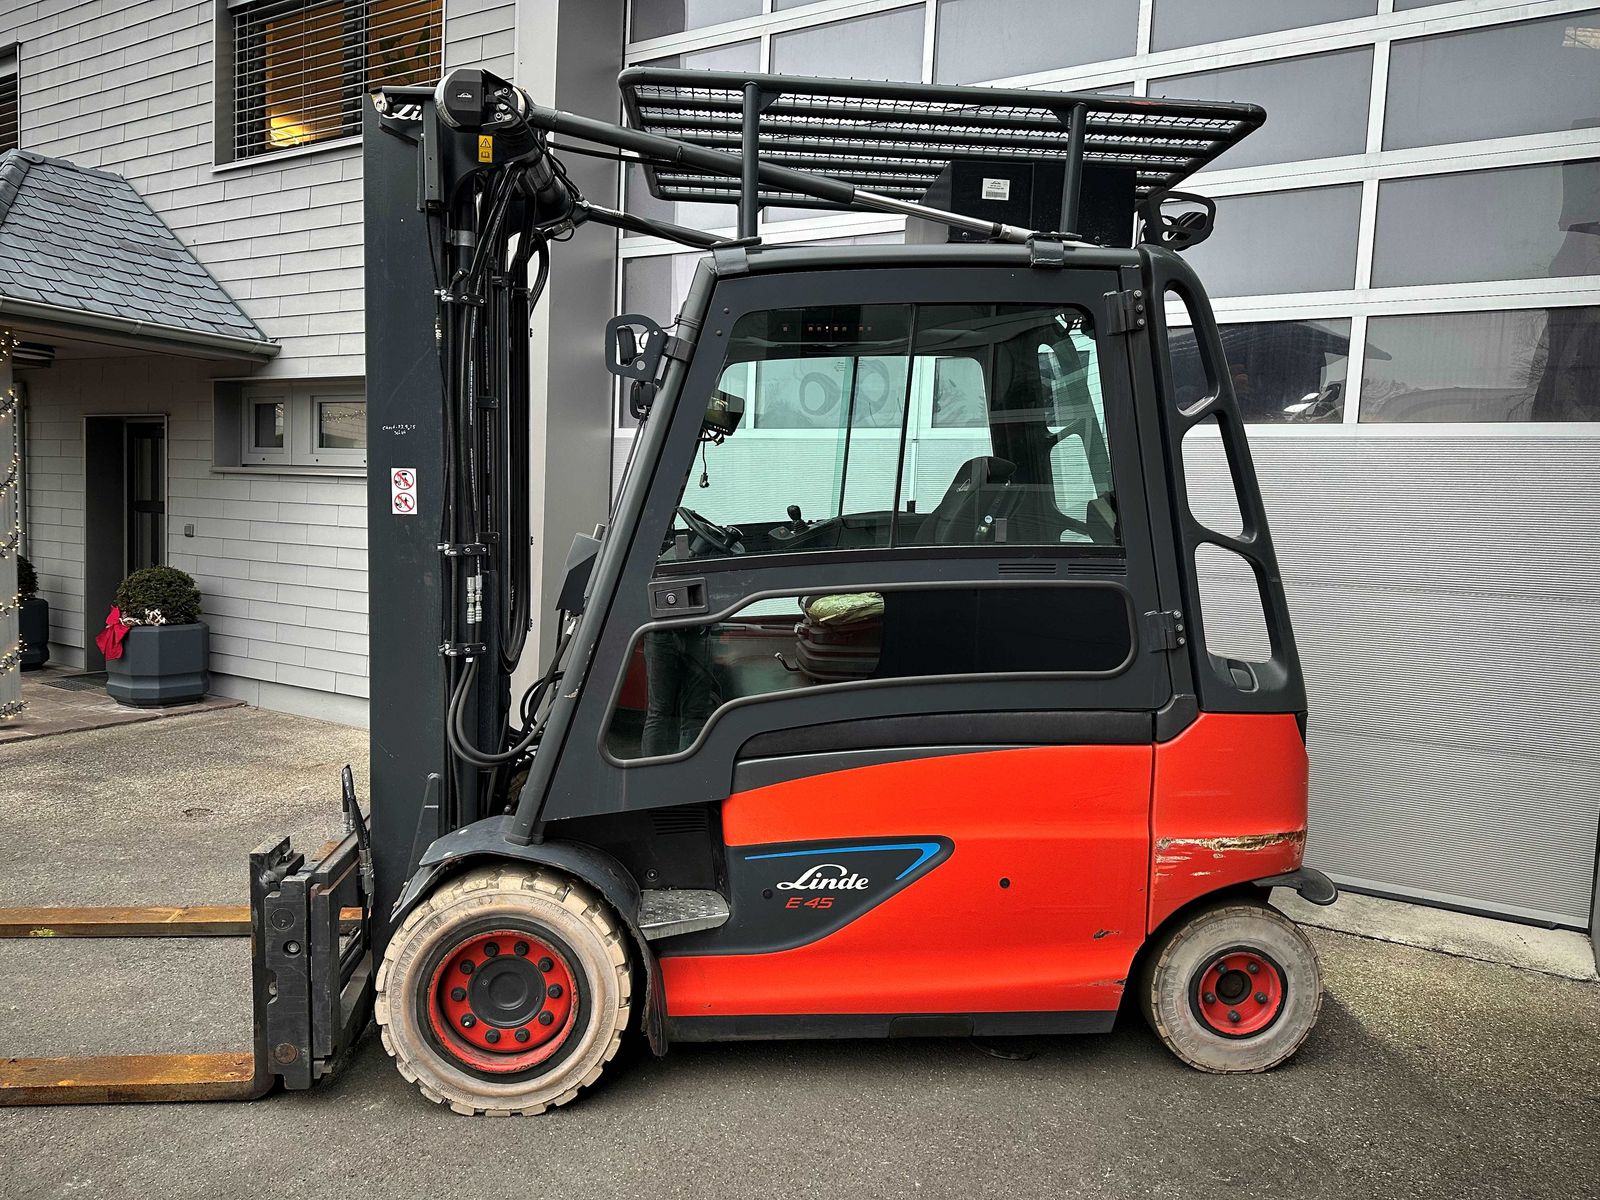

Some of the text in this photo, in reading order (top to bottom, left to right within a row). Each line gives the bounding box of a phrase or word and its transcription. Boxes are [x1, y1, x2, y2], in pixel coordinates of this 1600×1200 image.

[382, 104, 423, 121] Li
[776, 863, 869, 890] Linde
[785, 897, 835, 909] E 45
